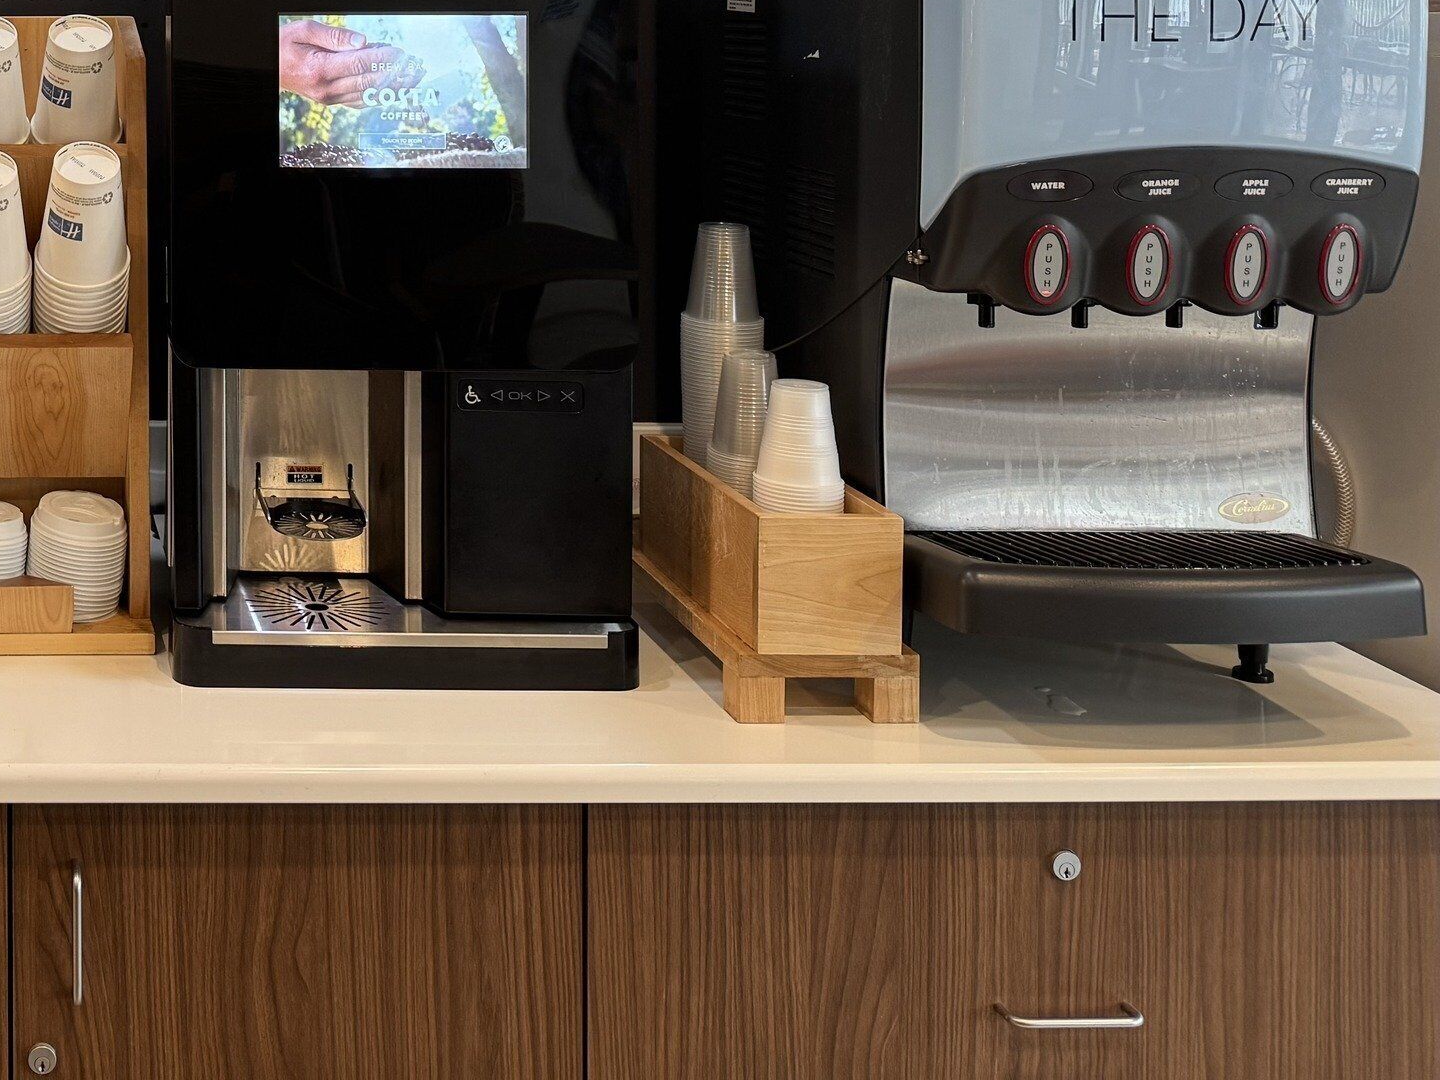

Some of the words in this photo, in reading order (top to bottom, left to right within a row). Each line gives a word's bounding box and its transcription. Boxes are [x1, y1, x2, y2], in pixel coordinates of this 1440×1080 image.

[362, 87, 439, 111] COSTA
[380, 111, 423, 121] COFFEE
[1030, 181, 1066, 190] WATER
[1141, 178, 1180, 187] ORANGE
[1242, 179, 1270, 187] APPLE
[1325, 178, 1374, 186] CRANBERRY
[1147, 188, 1172, 196] JUICE
[1242, 188, 1267, 196] JUICE
[1336, 187, 1359, 195] JUICE
[1043, 243, 1053, 287] PUSH
[1143, 243, 1154, 288] PUSH
[1242, 242, 1253, 287] PUSH
[1335, 241, 1346, 286] PUSH
[508, 391, 533, 401] OK
